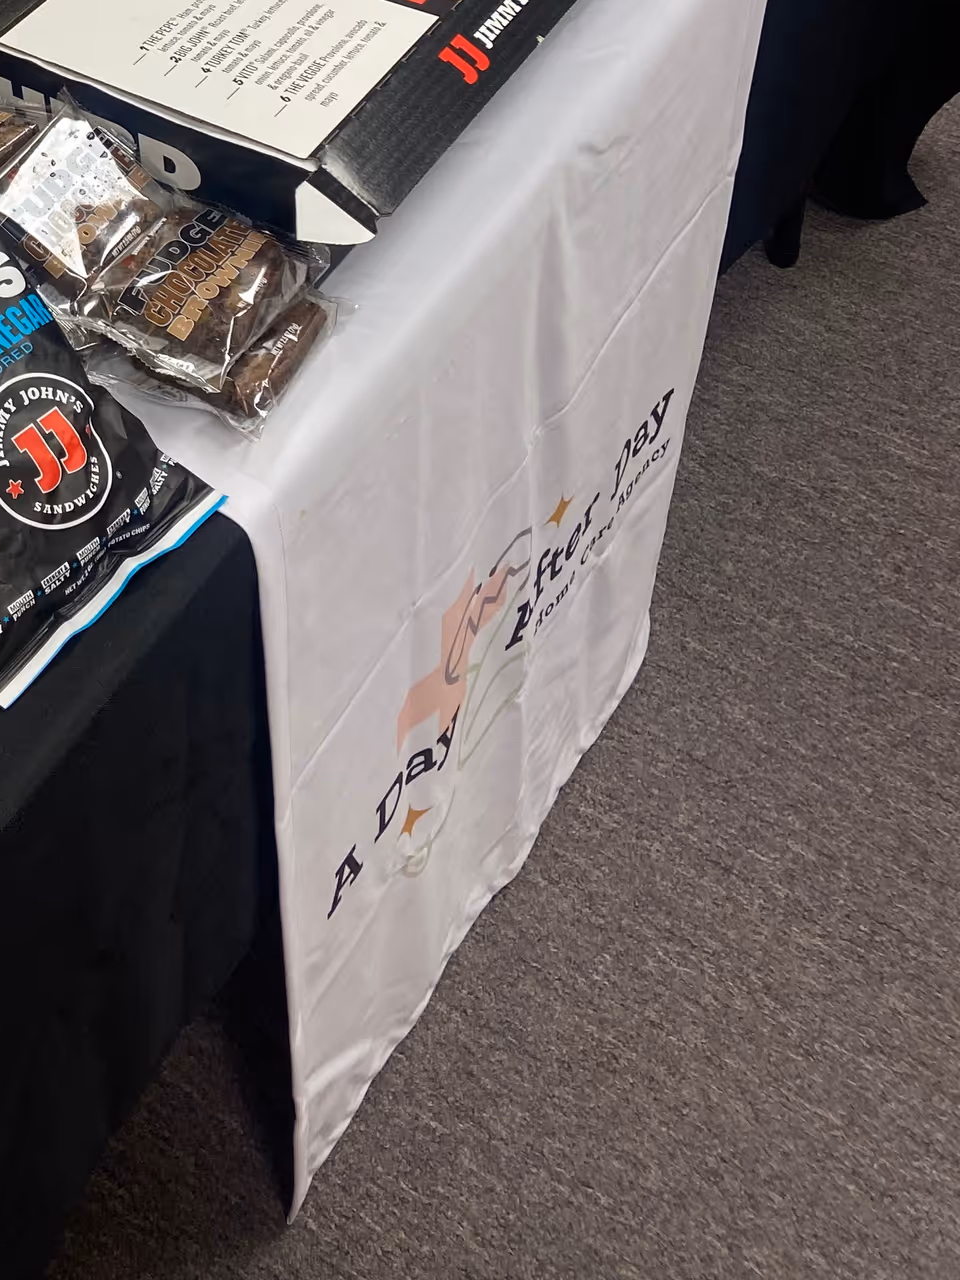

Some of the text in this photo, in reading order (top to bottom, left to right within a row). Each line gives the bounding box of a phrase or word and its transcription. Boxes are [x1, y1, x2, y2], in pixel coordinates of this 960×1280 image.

[200, 4, 216, 18] mayo
[316, 9, 334, 25] vinegar
[143, 34, 161, 50] THE
[176, 14, 226, 57] BIG Roast
[361, 22, 381, 42] tomato
[191, 30, 230, 62] tomato mayo
[206, 42, 235, 67] TURKEY
[222, 40, 261, 73] tomato mayo
[284, 79, 304, 94] THE
[297, 60, 325, 86] VEGGIE
[346, 20, 367, 38] avocado
[201, 63, 212, 73] 4
[437, 34, 491, 85] JJ
[233, 75, 244, 86] 5
[320, 92, 338, 106] mayo
[117, 208, 228, 316] FUDGE
[144, 218, 253, 327] CHOCOLATE
[19, 386, 84, 413] JOHN'S
[11, 406, 88, 493] JJ
[34, 455, 100, 514] SANDWICHES
[579, 515, 615, 566] Care
[616, 437, 672, 514] Agency
[131, 524, 150, 538] CHIPS
[77, 537, 100, 561] MOUTH
[44, 569, 71, 595] SALTY
[7, 590, 33, 614] MOUTH
[12, 599, 37, 621] PUNCH
[327, 387, 676, 920] A Day After Day
